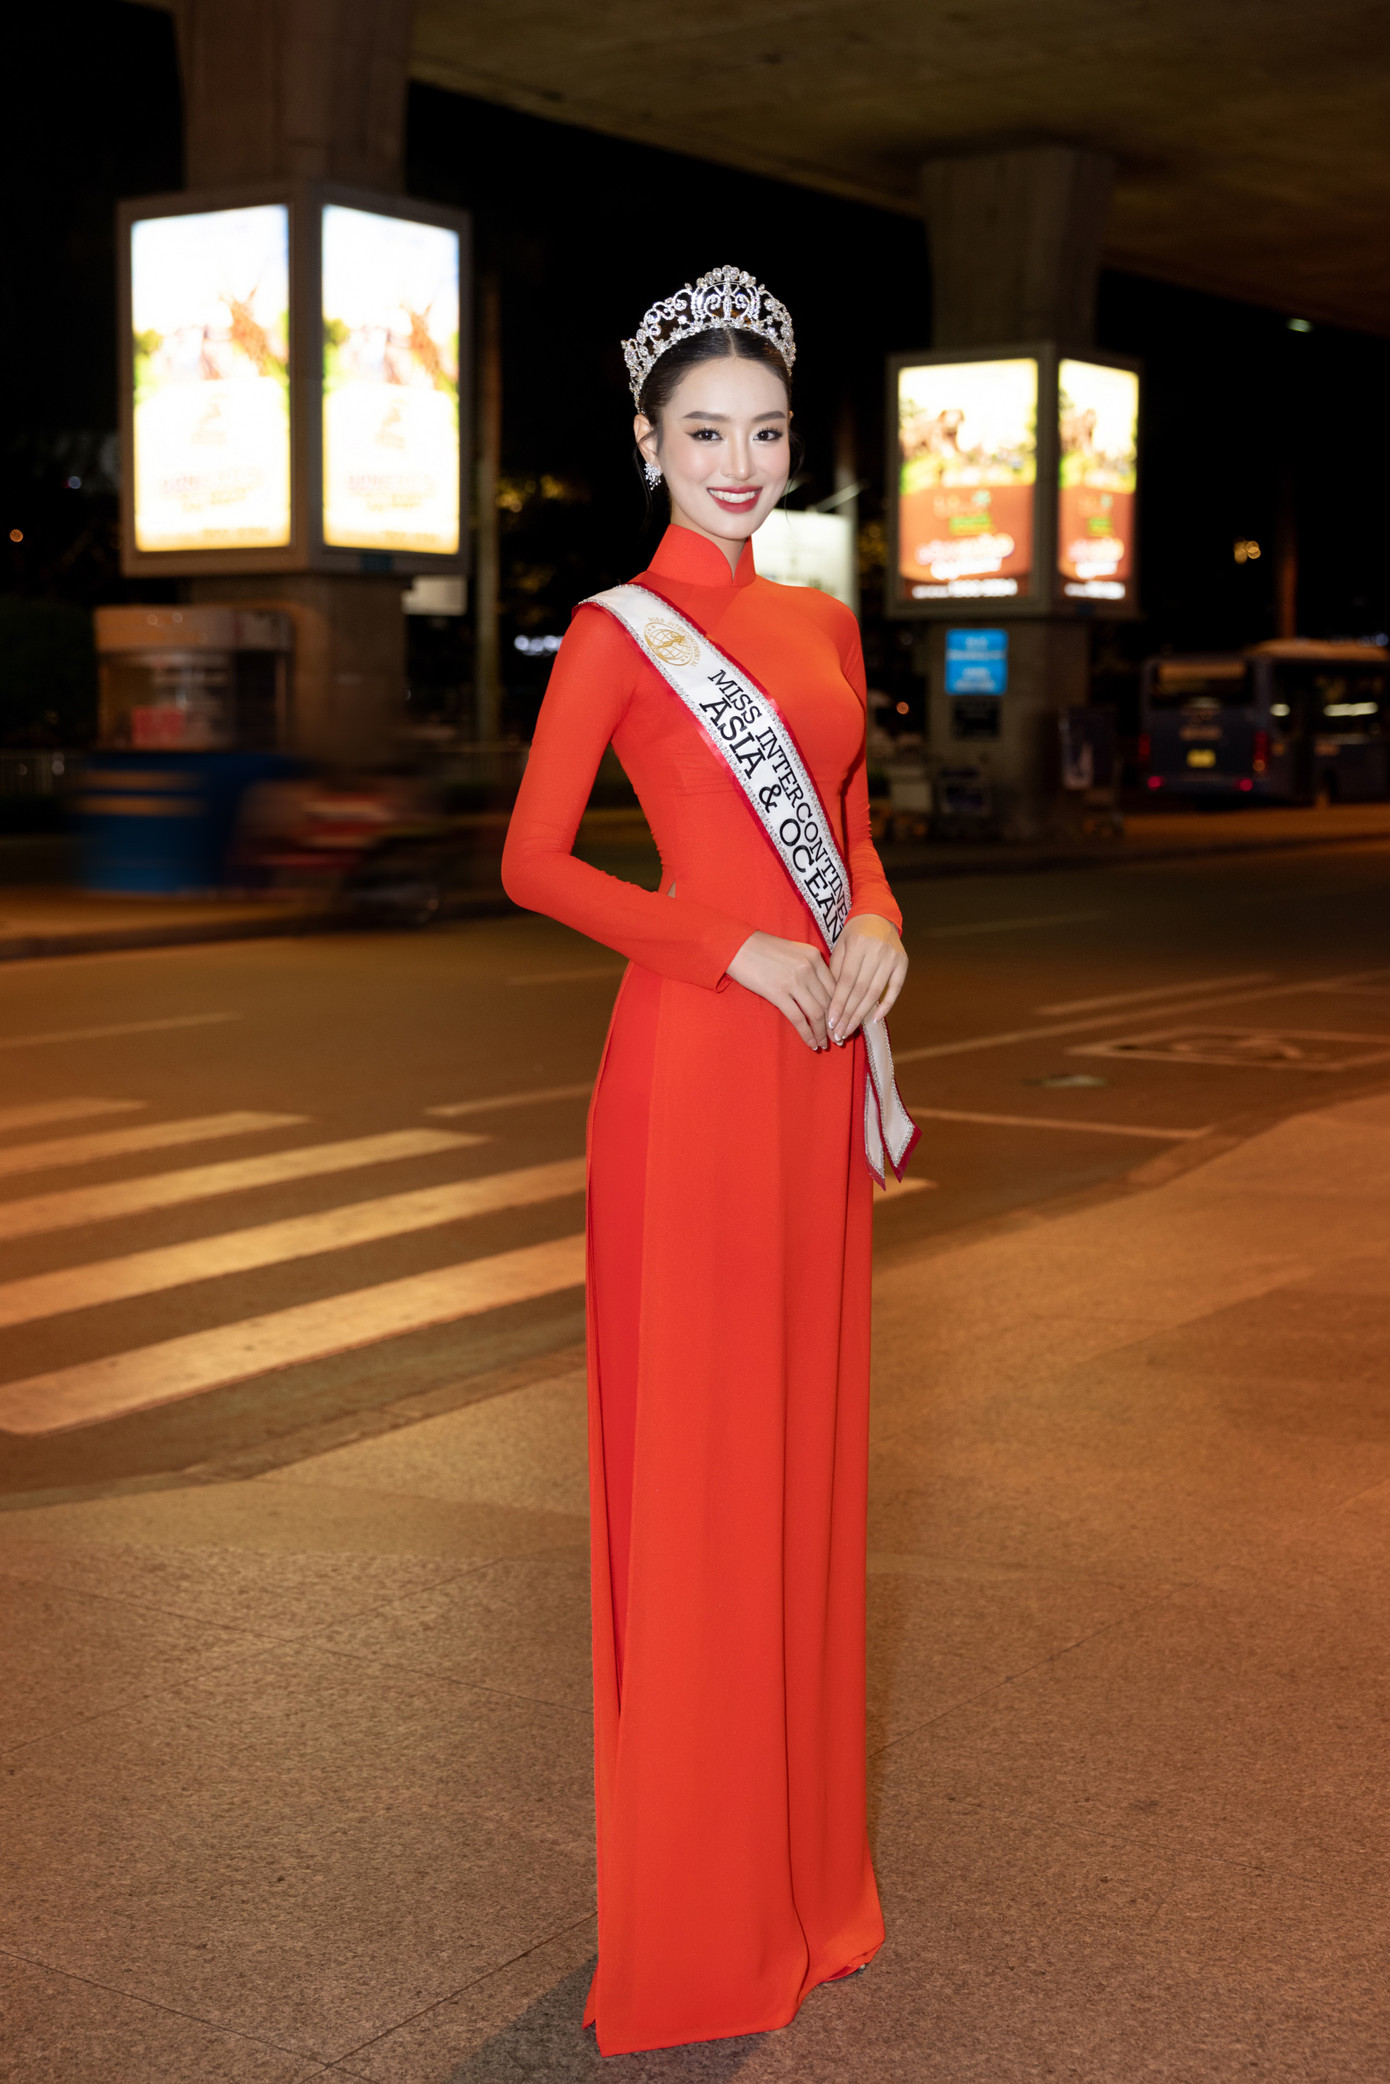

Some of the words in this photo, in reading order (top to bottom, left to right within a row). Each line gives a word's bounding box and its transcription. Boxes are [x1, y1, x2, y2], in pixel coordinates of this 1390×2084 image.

[699, 697, 766, 780] ASIA
[758, 784, 782, 813] &
[708, 669, 762, 724] MISS
[755, 726, 848, 929] INTERCONTINE
